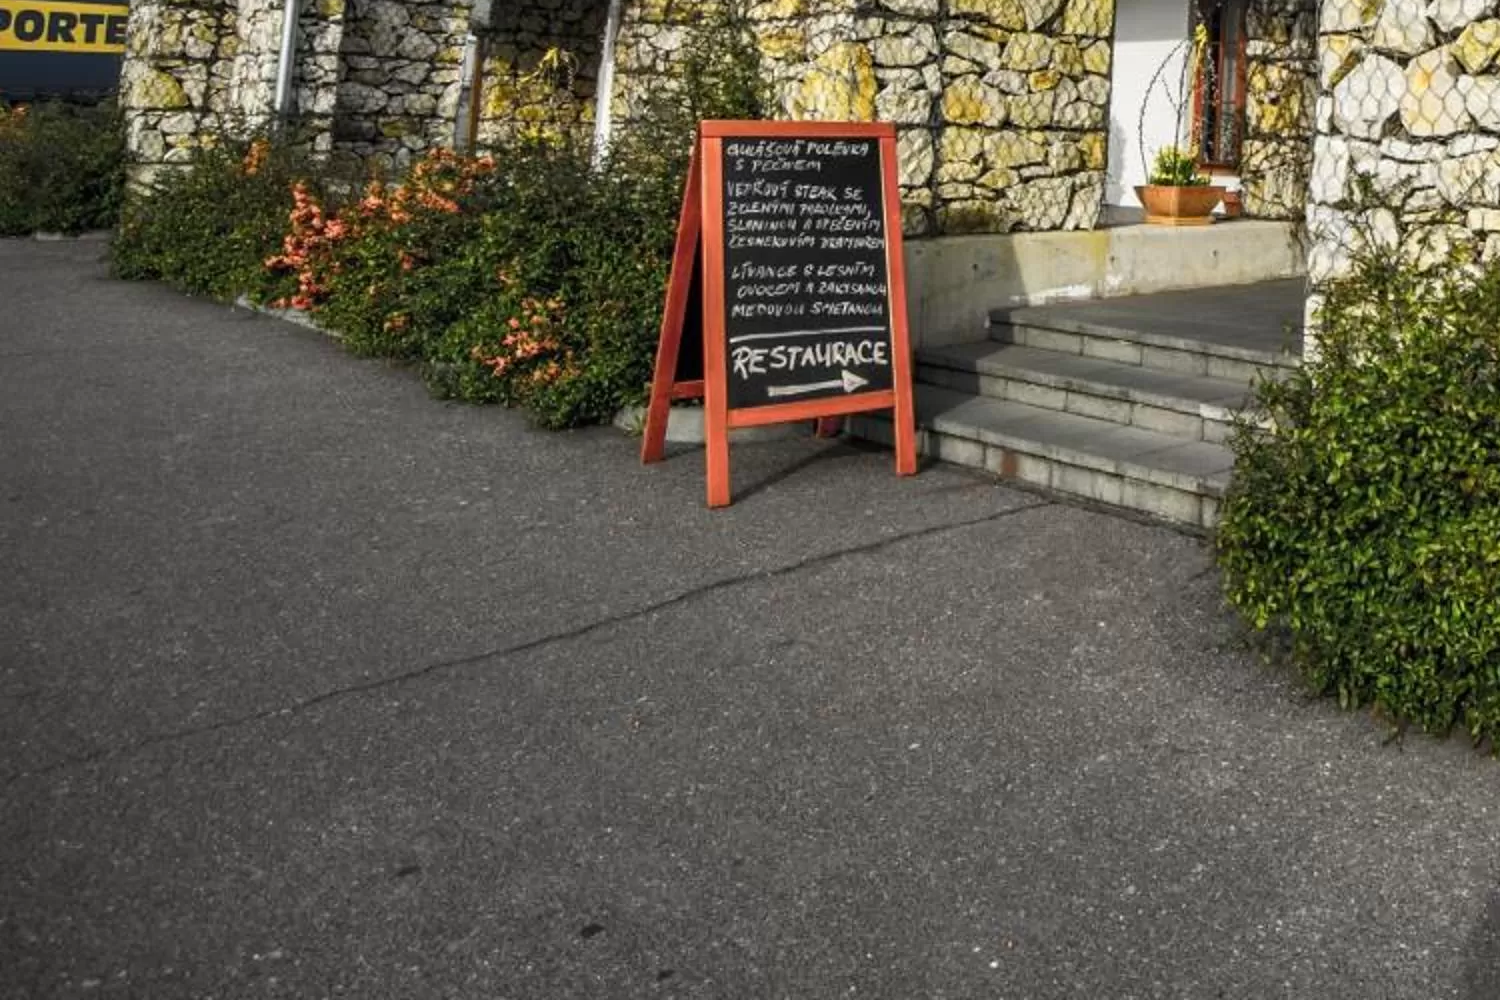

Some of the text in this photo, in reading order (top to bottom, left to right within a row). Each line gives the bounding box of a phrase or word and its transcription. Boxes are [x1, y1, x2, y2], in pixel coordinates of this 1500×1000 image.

[795, 184, 838, 201] STEAK
[844, 185, 864, 200] SE
[731, 340, 888, 380] RESTAURACE
